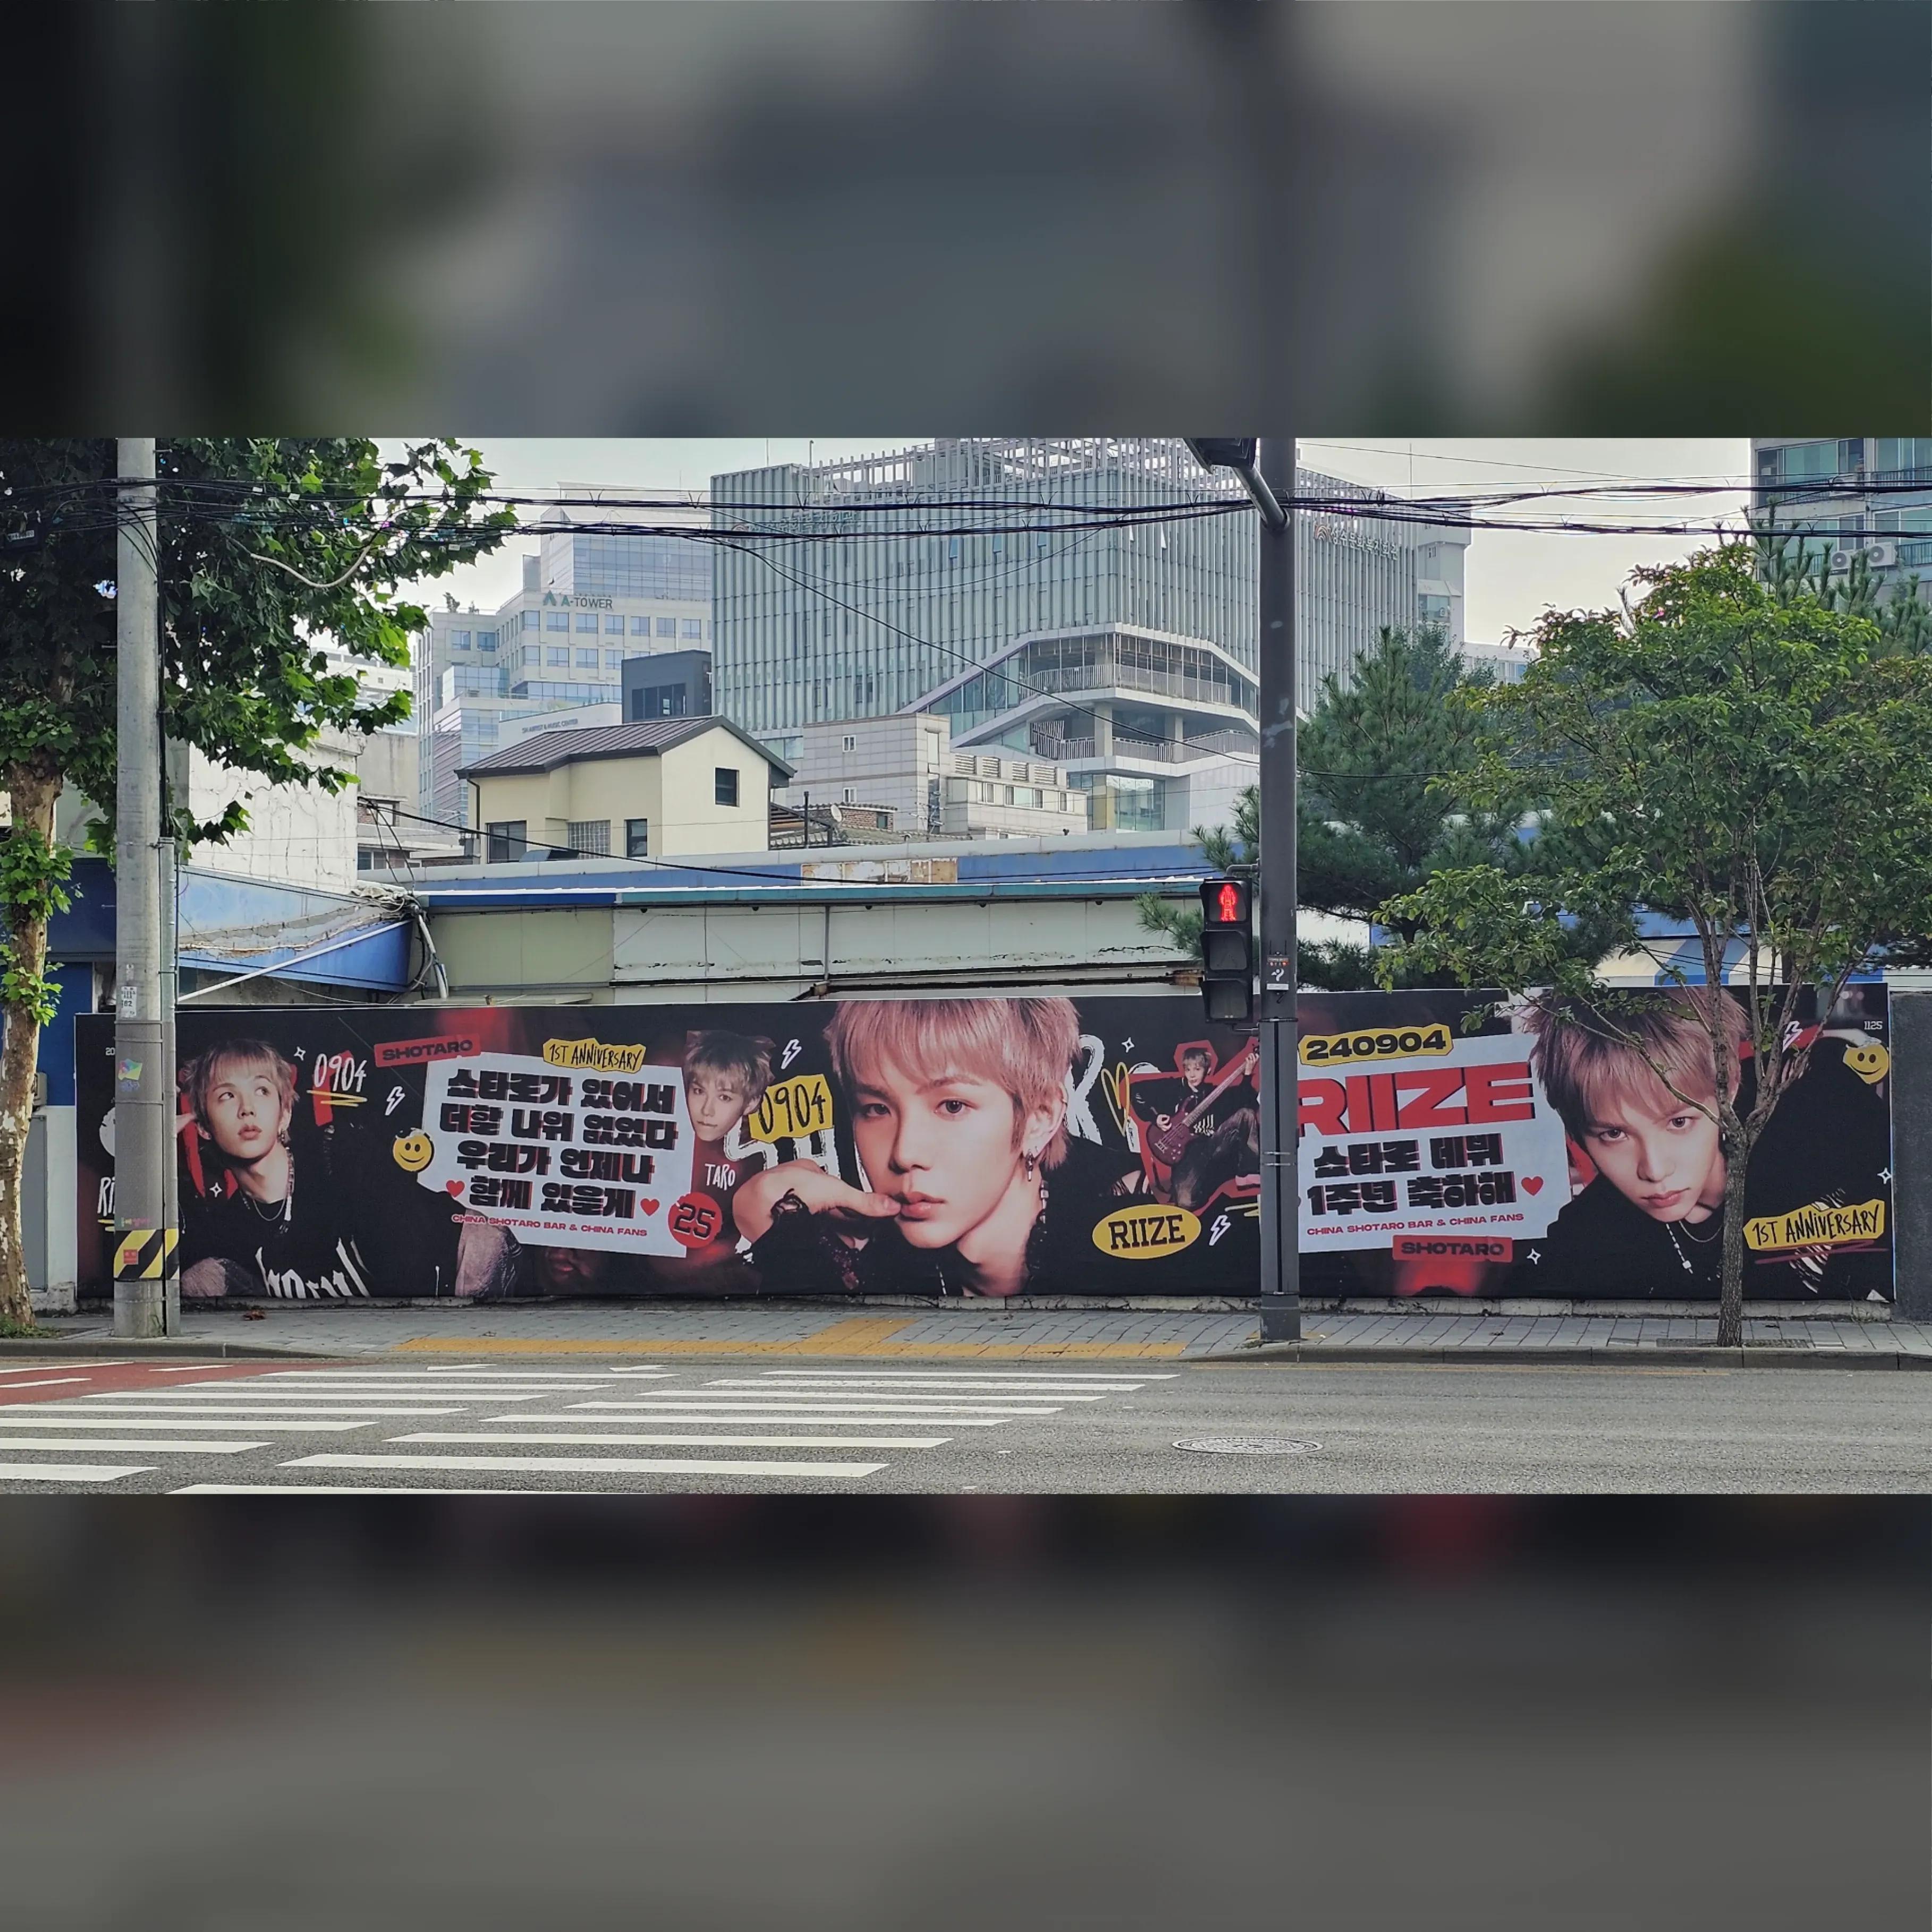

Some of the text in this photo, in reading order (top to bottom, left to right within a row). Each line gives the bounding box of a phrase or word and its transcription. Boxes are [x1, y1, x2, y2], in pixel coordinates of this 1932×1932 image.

[561, 595, 613, 609] A-TOWER
[1864, 1021, 1883, 1030] 1125
[383, 1039, 472, 1061] SHOTARO
[550, 1043, 642, 1071] 1ST ANNIVERSARY
[1307, 1030, 1446, 1060] 240904
[314, 1054, 367, 1092] 0904
[581, 1079, 676, 1114] 있어서
[758, 1081, 826, 1134] 0904
[1298, 1062, 1535, 1137] RIIZE
[439, 1103, 679, 1150] 더할 나위 없었다
[457, 1140, 655, 1184] 우리가 언제나
[1429, 1133, 1503, 1169] 데뷔
[705, 1163, 736, 1191] TARO
[1307, 1171, 1516, 1216] 1주년 축하해
[469, 1175, 636, 1218] 함께 있을게
[488, 1218, 541, 1228] SHOTARO
[581, 1225, 614, 1234] CHINA
[617, 1228, 647, 1237] FANS
[673, 1202, 716, 1240] 25
[1108, 1214, 1185, 1250] RIIZE
[1307, 1225, 1343, 1235] CHINA
[1347, 1222, 1404, 1233] SHOTARO
[1408, 1219, 1433, 1228] BAR
[1449, 1215, 1486, 1225] CHINA
[1490, 1213, 1524, 1222] FANS
[1752, 1204, 1879, 1245] 1ST ANNIVERSARY
[1401, 1242, 1504, 1255] SHOTARO
